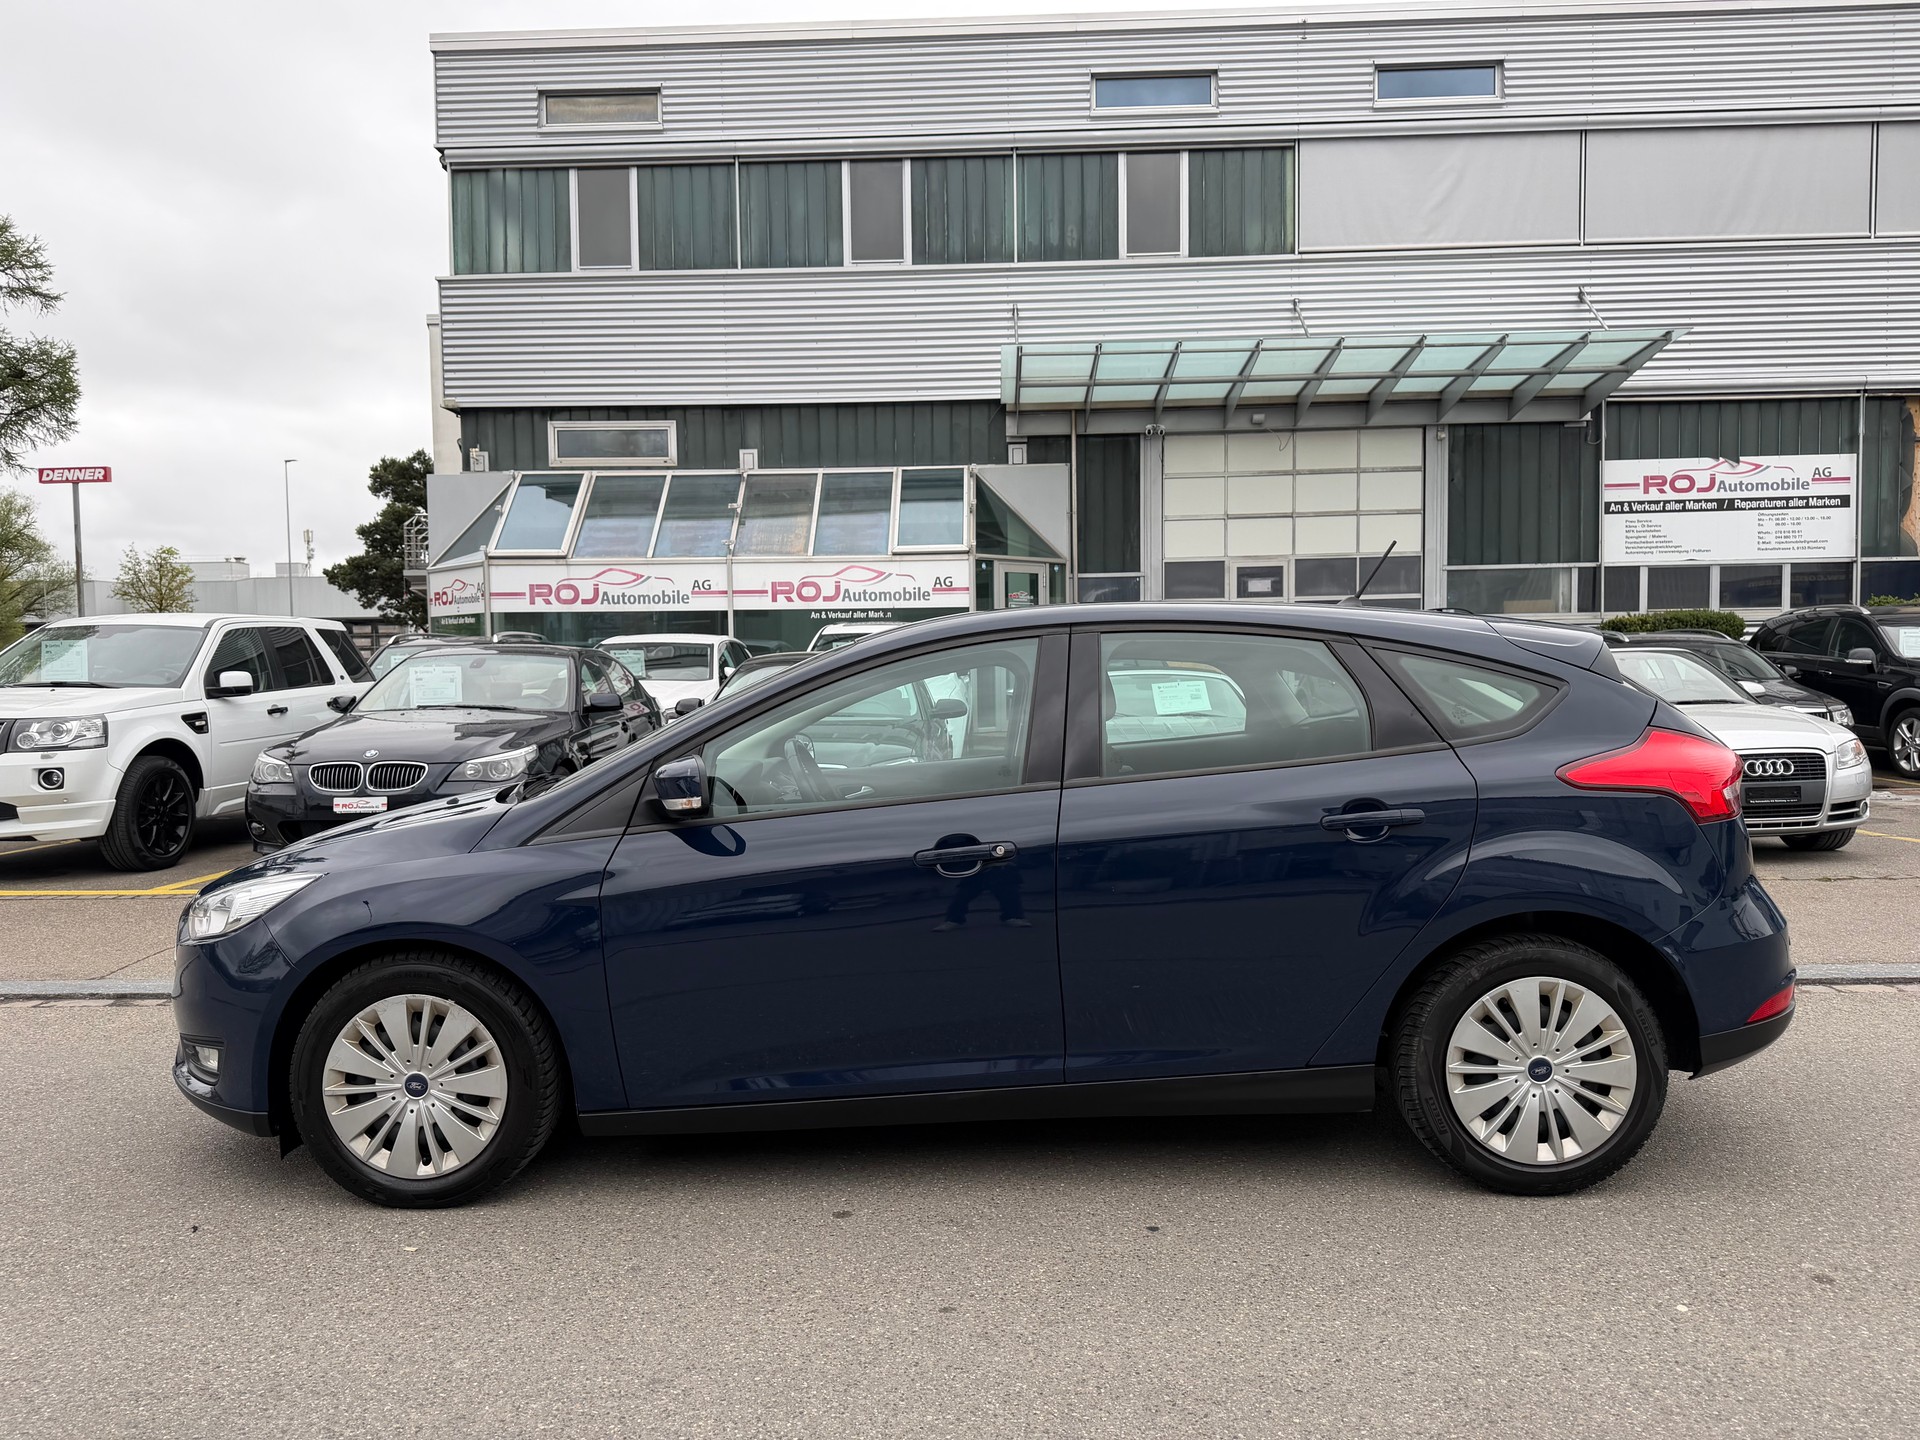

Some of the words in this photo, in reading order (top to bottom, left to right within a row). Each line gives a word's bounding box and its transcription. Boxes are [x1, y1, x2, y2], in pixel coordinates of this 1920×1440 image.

[41, 468, 105, 481] DENNER
[1643, 474, 1717, 494] ROJ
[1717, 477, 1810, 493] Automobile
[1812, 466, 1832, 478] AG
[1609, 502, 1621, 512] An
[1623, 502, 1630, 512] &
[1631, 502, 1663, 512] Verkauf
[1665, 501, 1684, 511] aller
[1685, 500, 1718, 510] Marken
[1734, 499, 1787, 510] Reparaturen
[1788, 497, 1807, 507] aller
[1808, 497, 1841, 507] Marken
[528, 583, 599, 605] ROJ
[600, 590, 690, 605] Automobile
[691, 579, 712, 591] AG
[771, 581, 841, 603] ROJ
[841, 587, 931, 602] Automobile
[933, 576, 953, 588] AG
[434, 590, 454, 607] ROJ
[810, 611, 820, 619] An
[821, 611, 827, 619] &
[827, 610, 852, 619] Verkauf
[853, 610, 868, 618] aller
[868, 610, 892, 618] Markn
